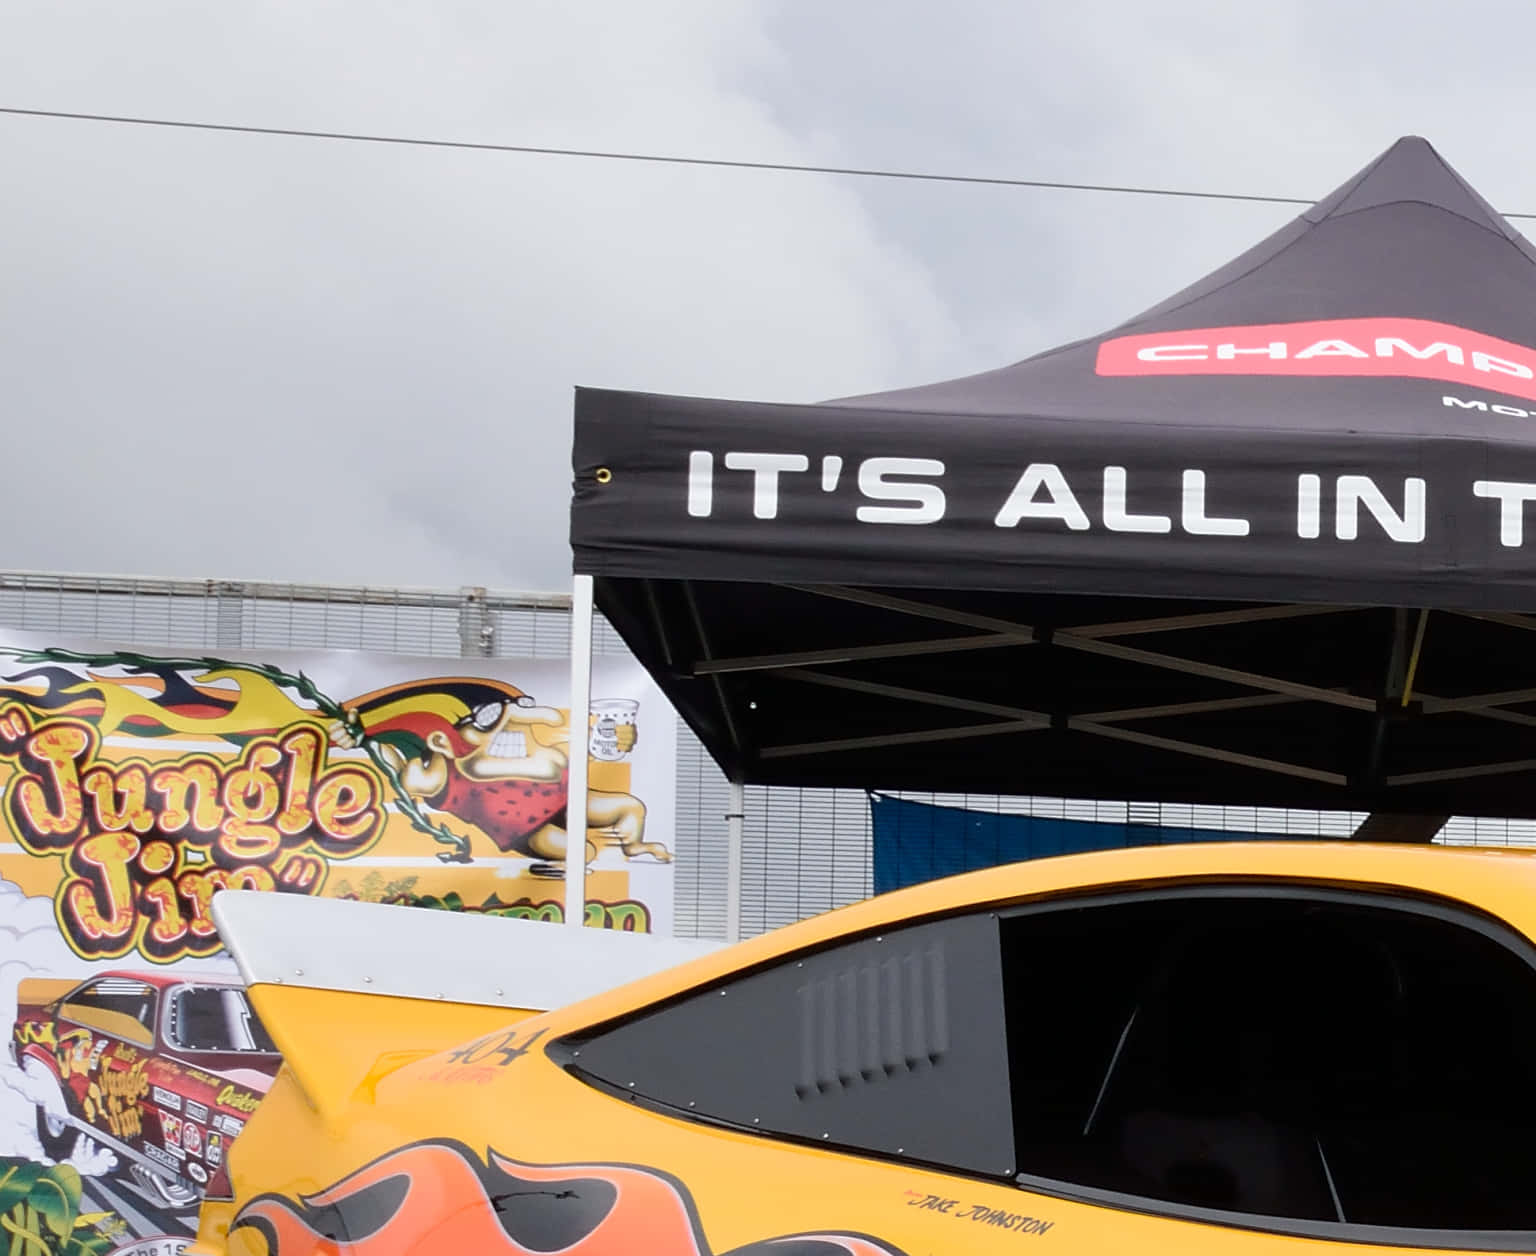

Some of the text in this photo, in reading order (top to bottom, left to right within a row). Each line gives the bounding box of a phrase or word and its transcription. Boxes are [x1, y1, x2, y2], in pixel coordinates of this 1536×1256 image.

[687, 450, 948, 524] IT'S
[994, 463, 1250, 536] ALL
[1297, 473, 1427, 543] IN
[908, 1194, 1055, 1236] JAKE JOHNSTON
